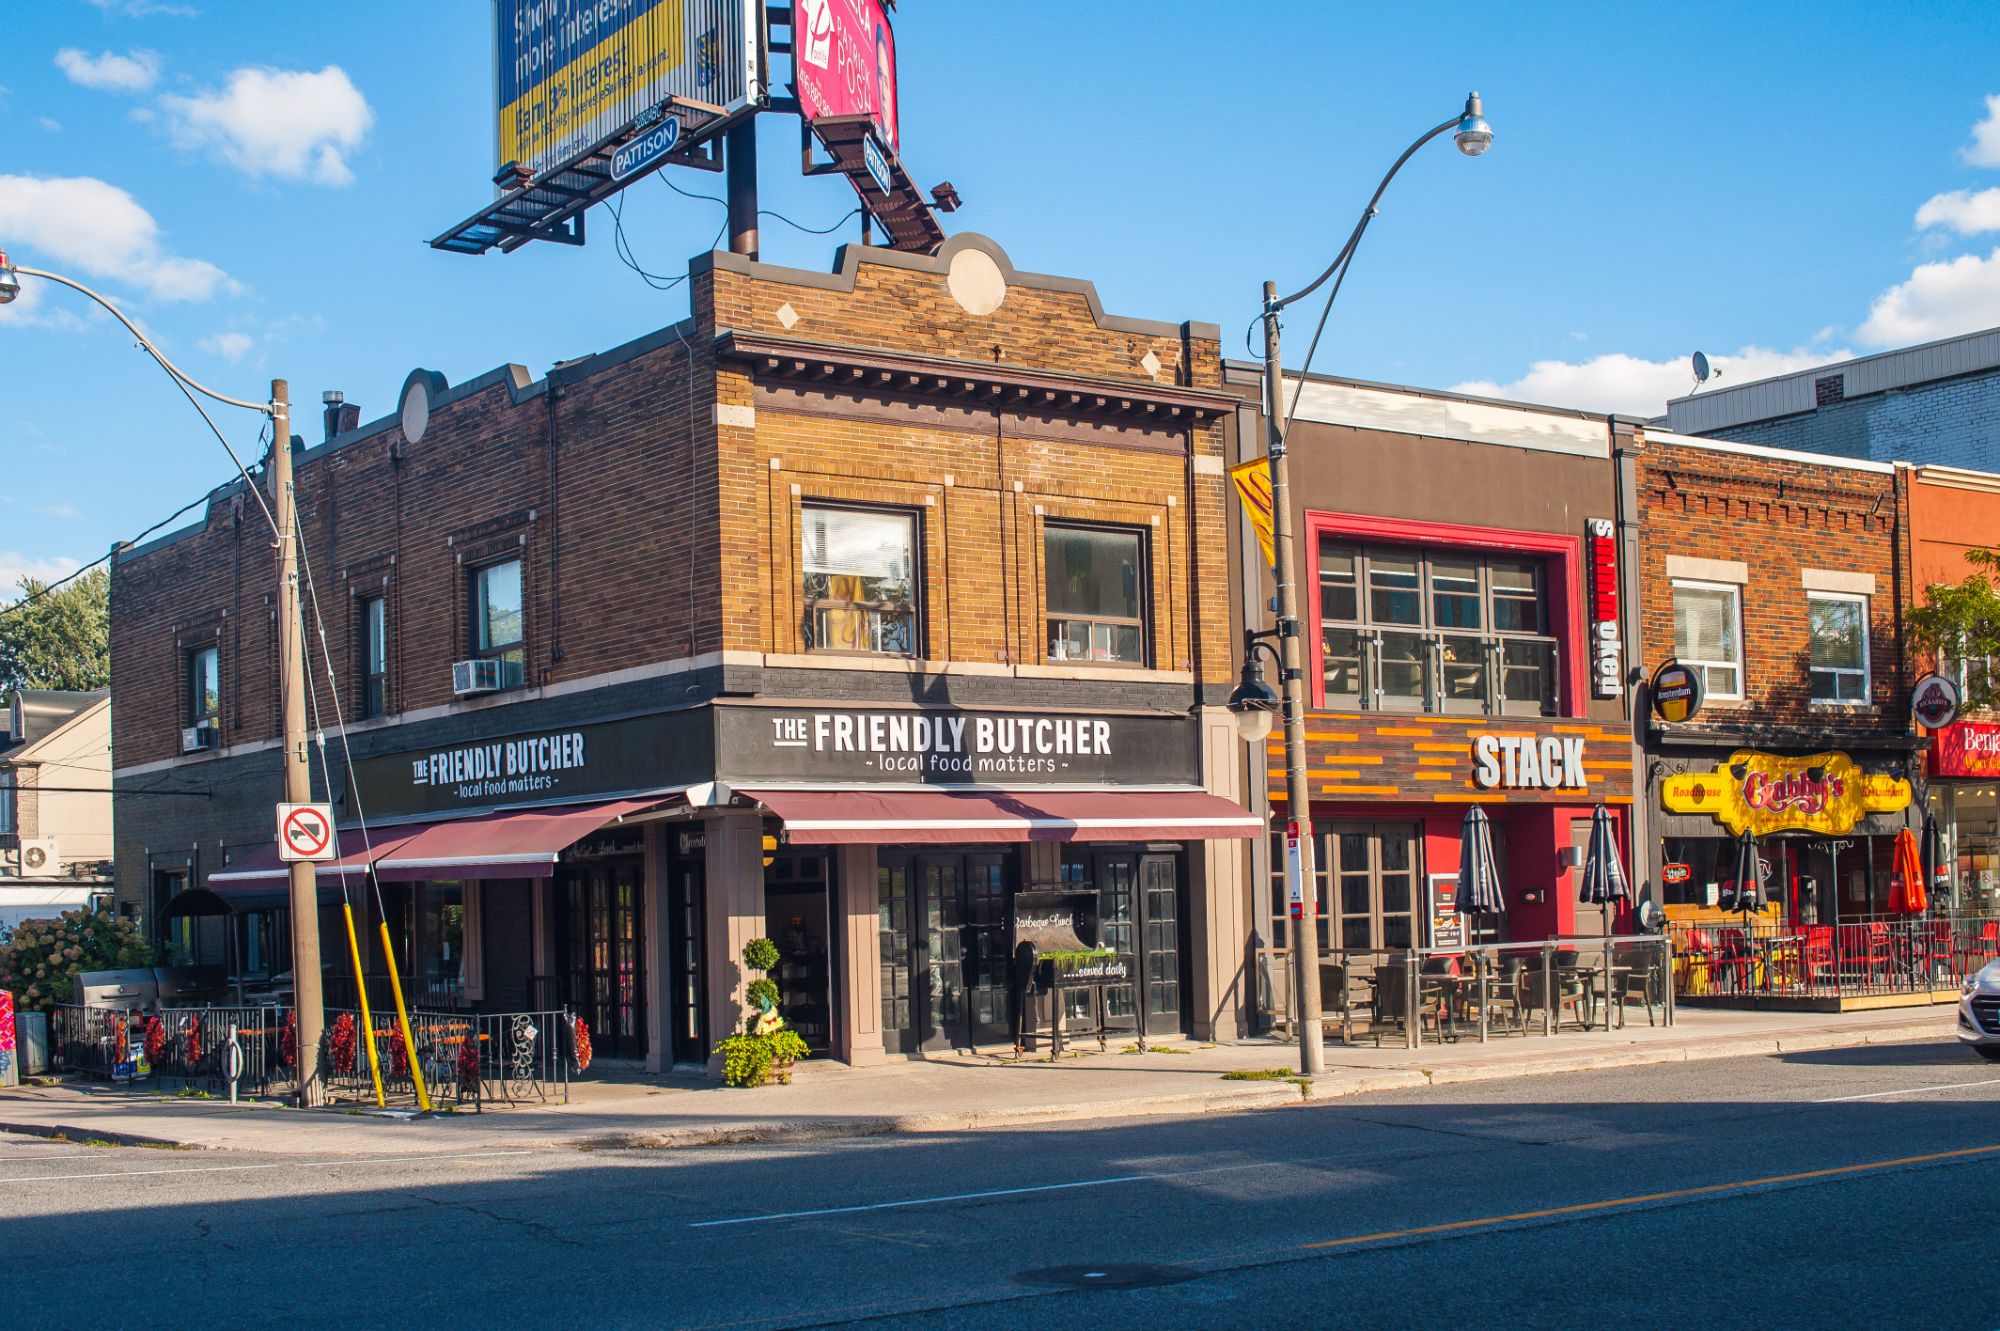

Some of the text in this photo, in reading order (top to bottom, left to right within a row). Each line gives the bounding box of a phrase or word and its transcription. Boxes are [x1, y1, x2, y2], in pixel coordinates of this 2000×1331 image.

[515, 35, 556, 83] more
[837, 15, 871, 92] PATRICK
[516, 43, 627, 135] Earn 3% interest
[616, 123, 673, 173] PATTISON
[1658, 687, 1692, 700] Amsterdam
[773, 714, 1112, 755] THE FRIENDLY BUTCHER
[412, 732, 585, 785] THE FRIENDLY BUTCHER
[879, 753, 1056, 773] local food matters
[1475, 735, 1588, 788] STACK
[459, 775, 552, 798] local food matters
[1672, 786, 1722, 798] Roadhouse
[1742, 770, 1844, 816] Gabby's
[1861, 785, 1905, 798] Restaurant
[1105, 961, 1126, 978] daily
